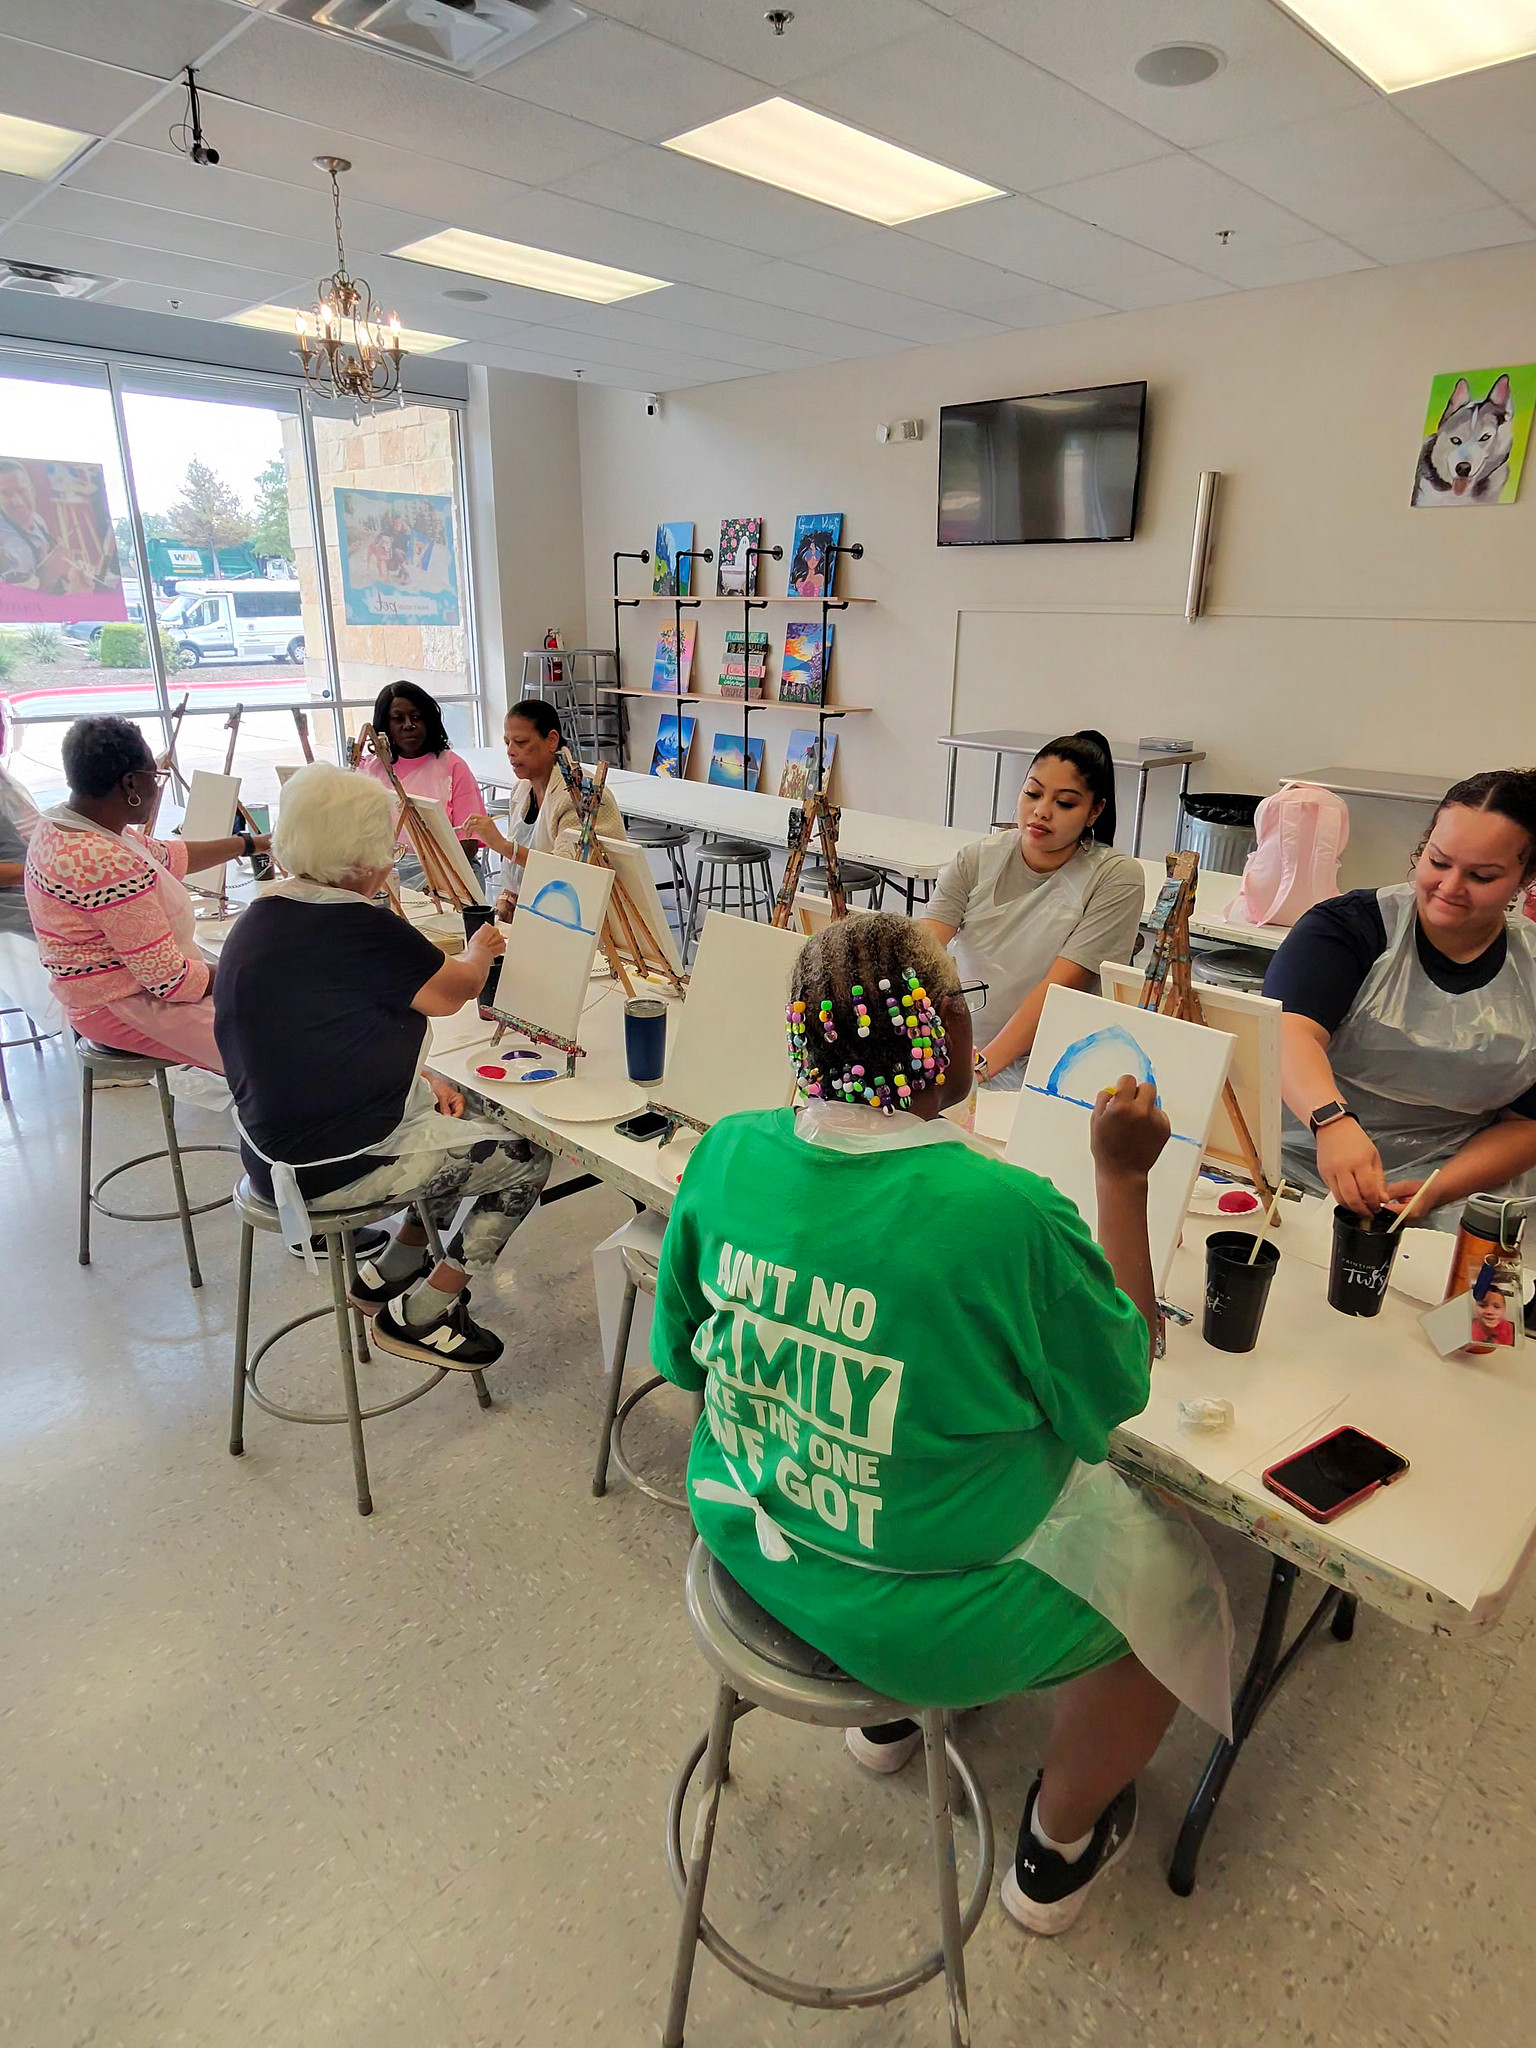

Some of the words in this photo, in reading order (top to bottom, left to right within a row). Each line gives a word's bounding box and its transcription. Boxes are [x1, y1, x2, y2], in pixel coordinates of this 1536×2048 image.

[716, 1241, 797, 1316] AIN'T
[806, 1275, 877, 1342] NO
[418, 1324, 467, 1353] N
[748, 1398, 801, 1454] THE
[809, 1433, 881, 1488] ONE
[775, 1455, 883, 1550] GOT
